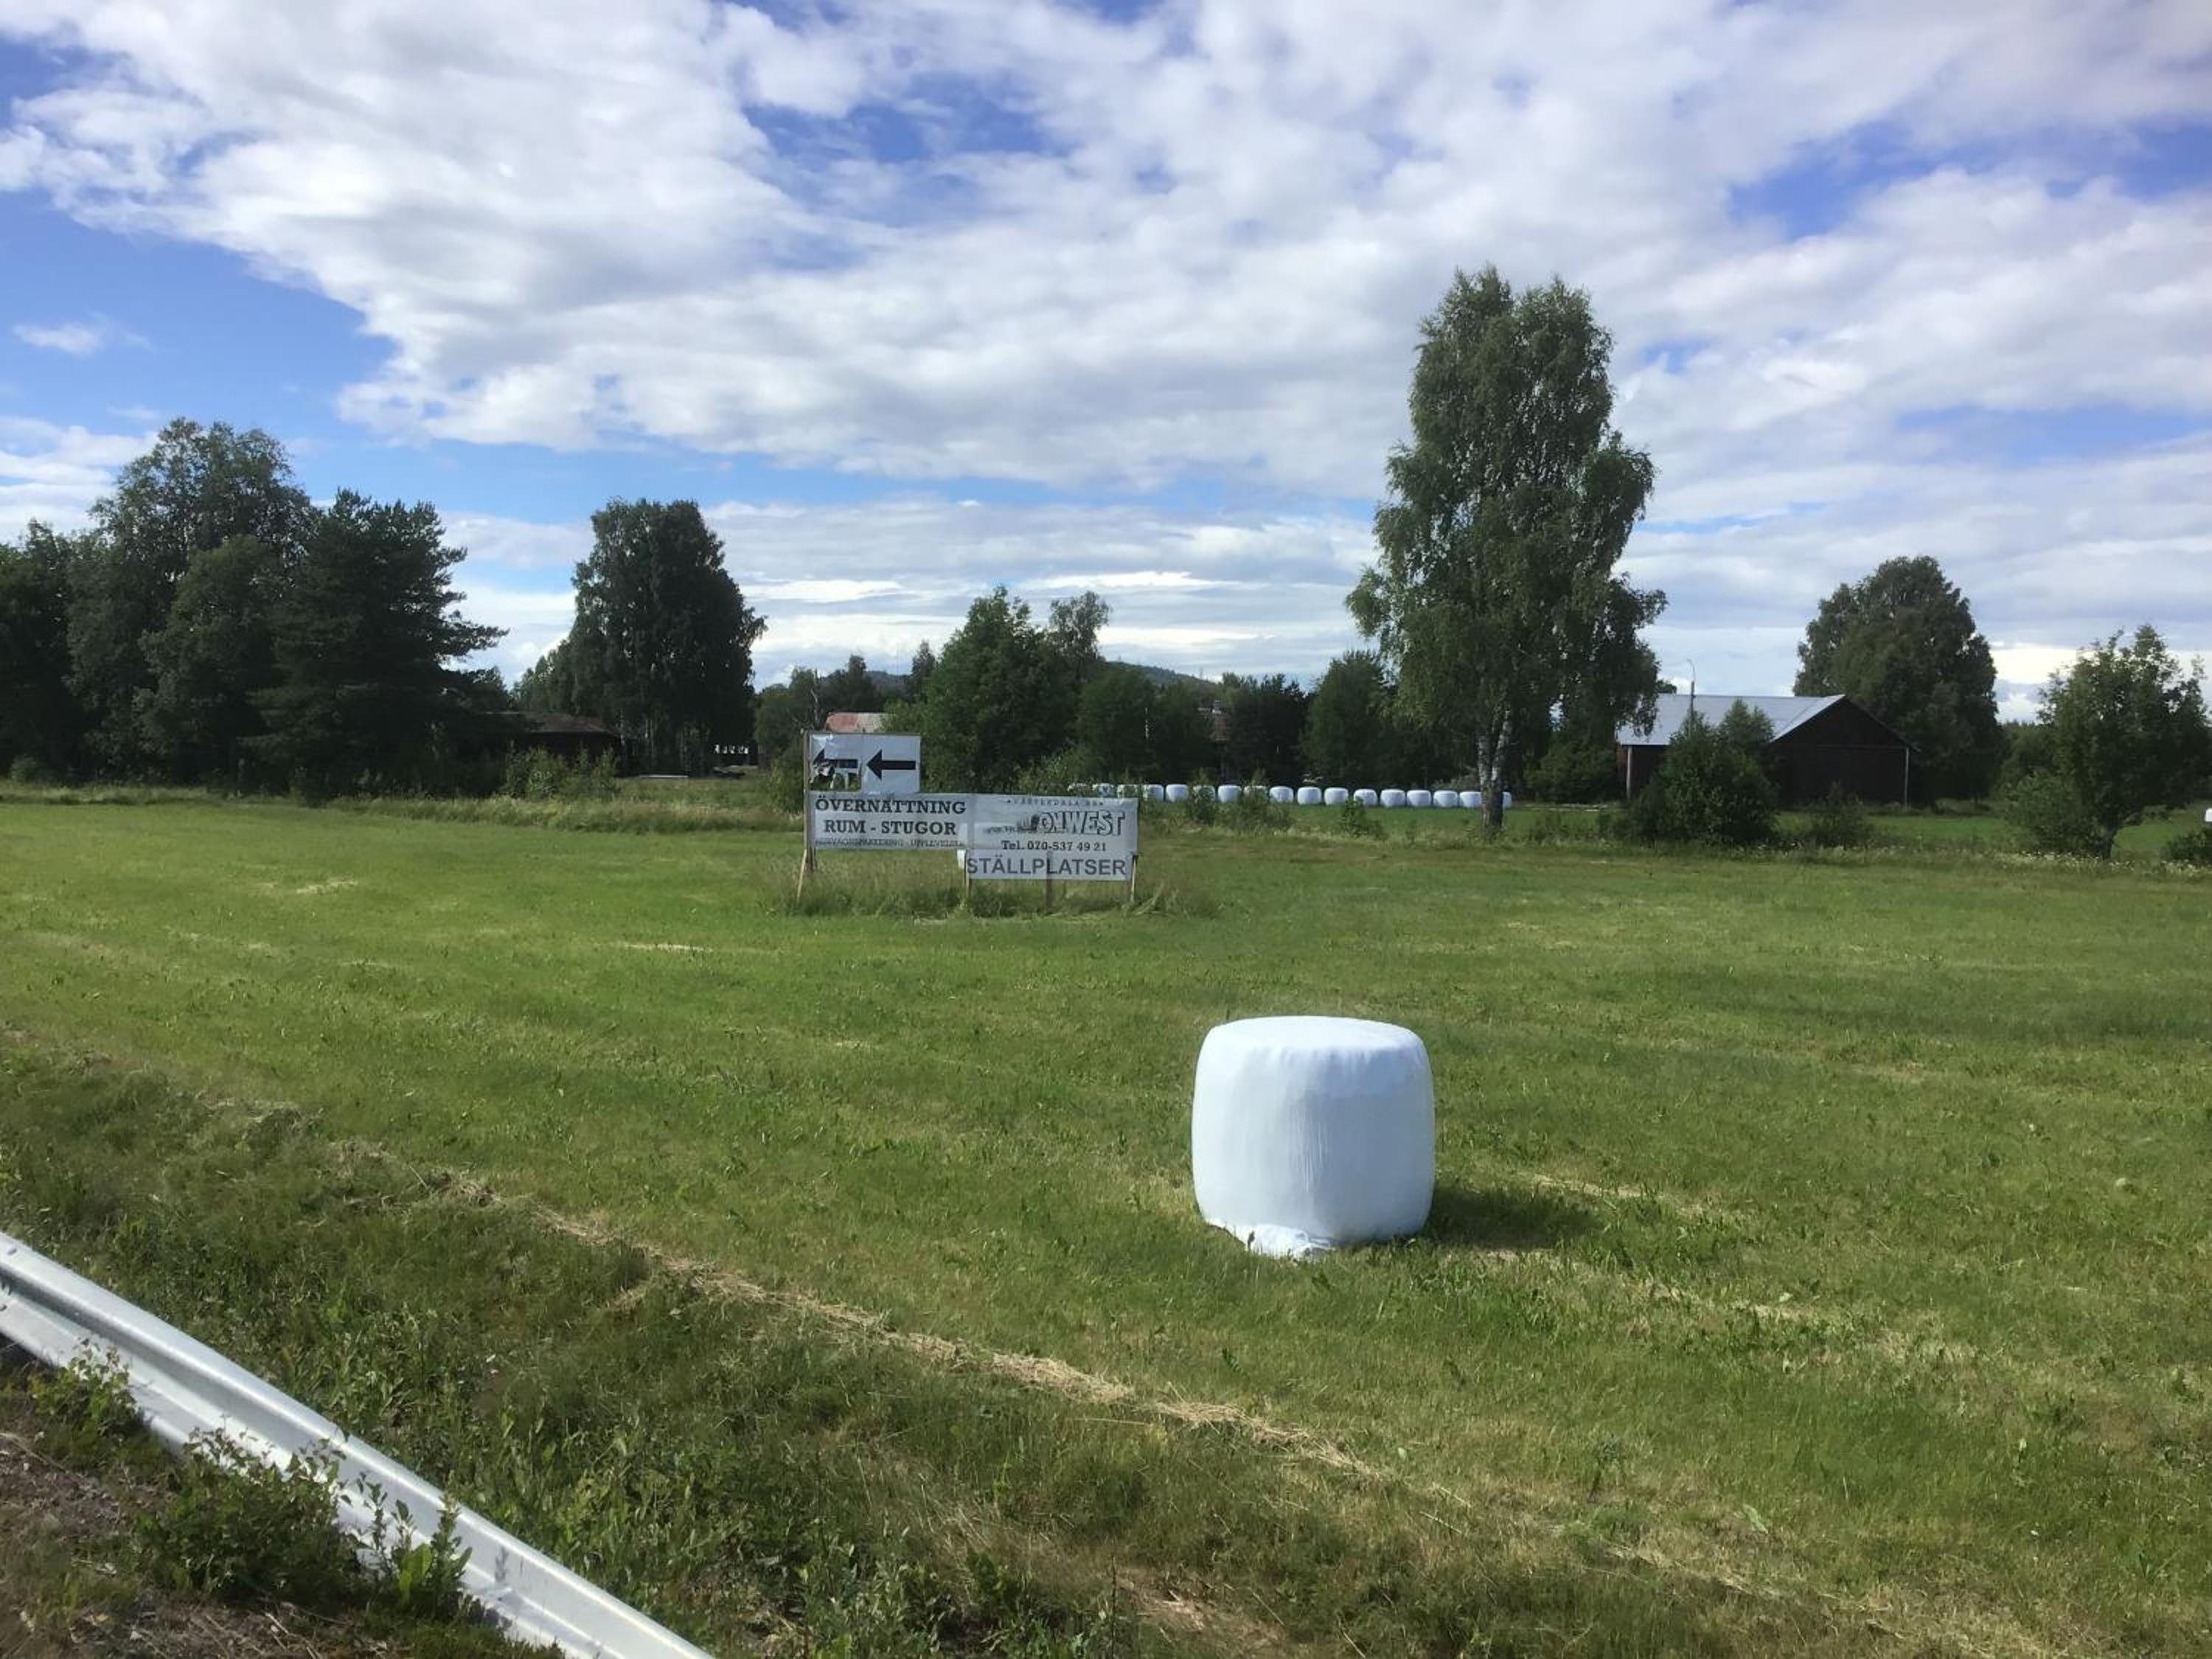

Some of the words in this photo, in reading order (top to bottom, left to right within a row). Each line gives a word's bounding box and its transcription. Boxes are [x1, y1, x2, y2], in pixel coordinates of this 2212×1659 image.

[824, 819, 866, 834] RUM
[881, 820, 957, 835] STUGOR
[1001, 840, 1025, 850] Tel.
[1093, 842, 1107, 852] 21
[967, 854, 1127, 874] STÄLLPLATSER
